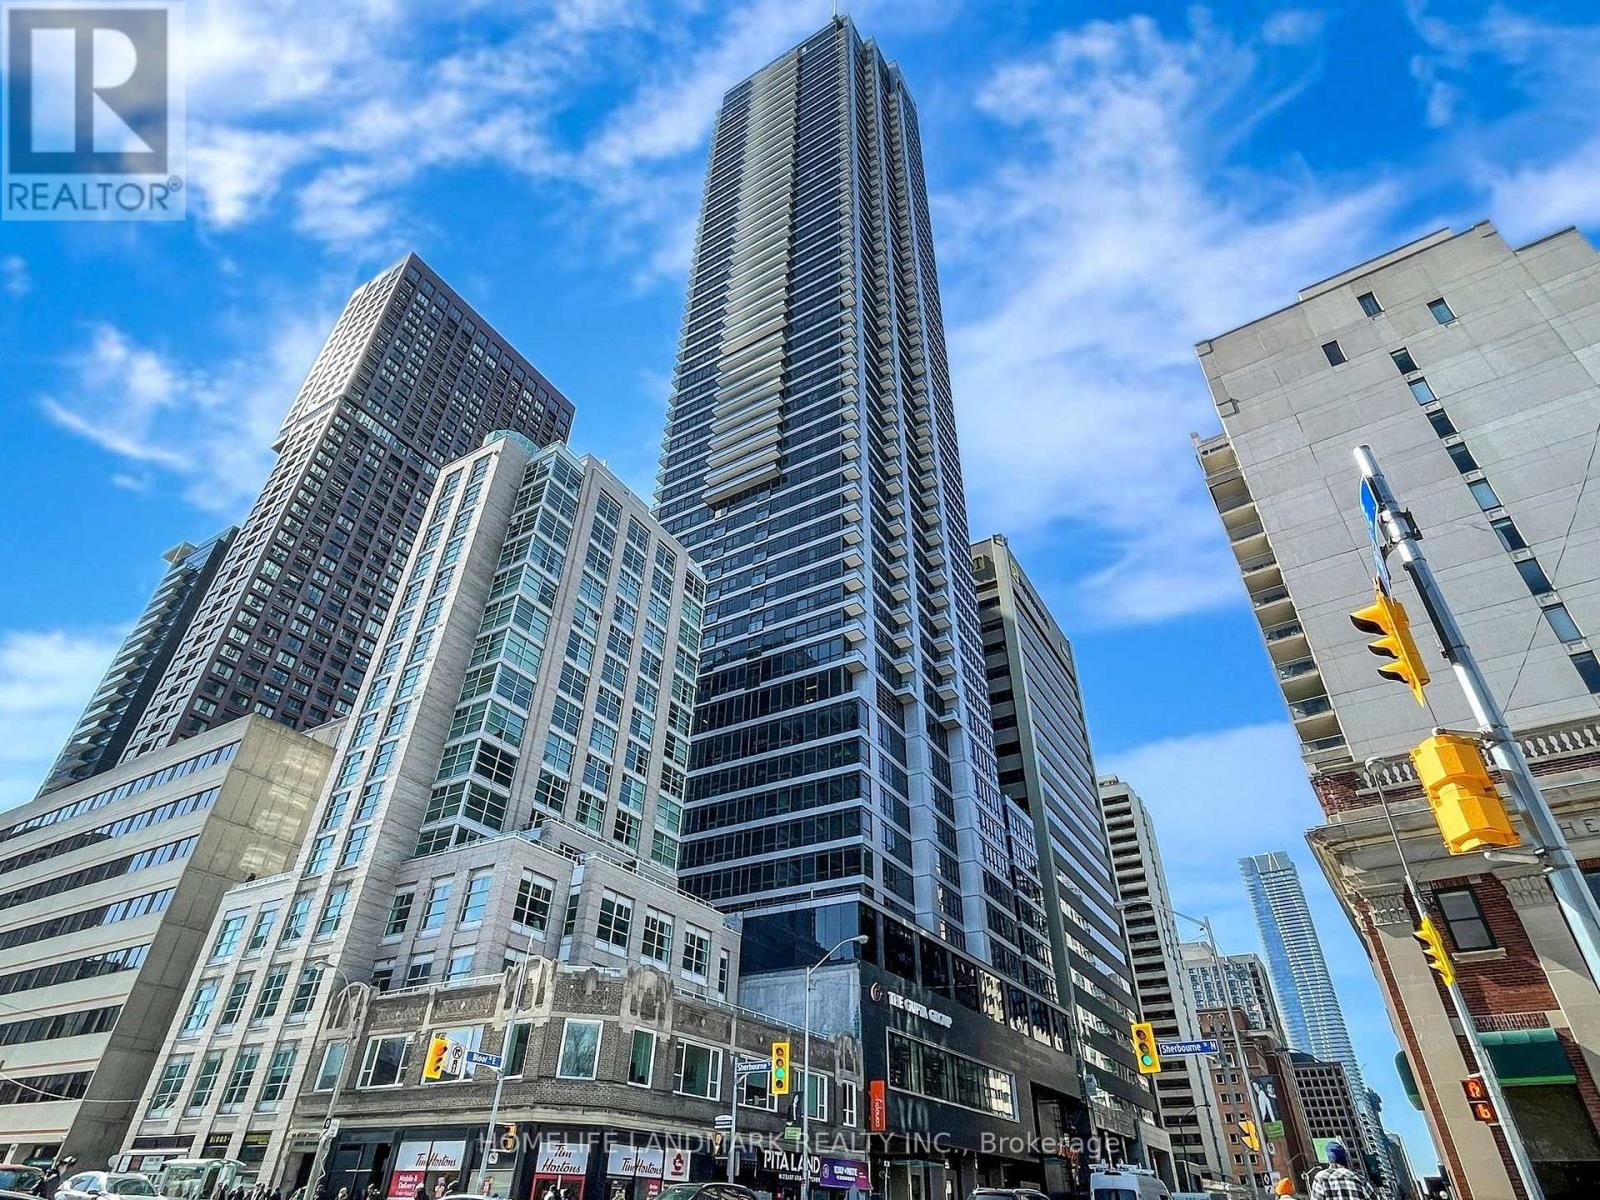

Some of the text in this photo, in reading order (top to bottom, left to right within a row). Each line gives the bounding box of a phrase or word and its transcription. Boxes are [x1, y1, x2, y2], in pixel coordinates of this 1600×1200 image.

[1161, 1043, 1201, 1054] Sherbourne
[1209, 1041, 1217, 1051] N
[737, 1062, 767, 1072] Sherbourne
[554, 1144, 572, 1158] Tim
[427, 1152, 456, 1167] Hortons
[541, 1158, 581, 1173] Hortons
[622, 1157, 662, 1175] Tim Hortons
[764, 1150, 790, 1171] PITA
